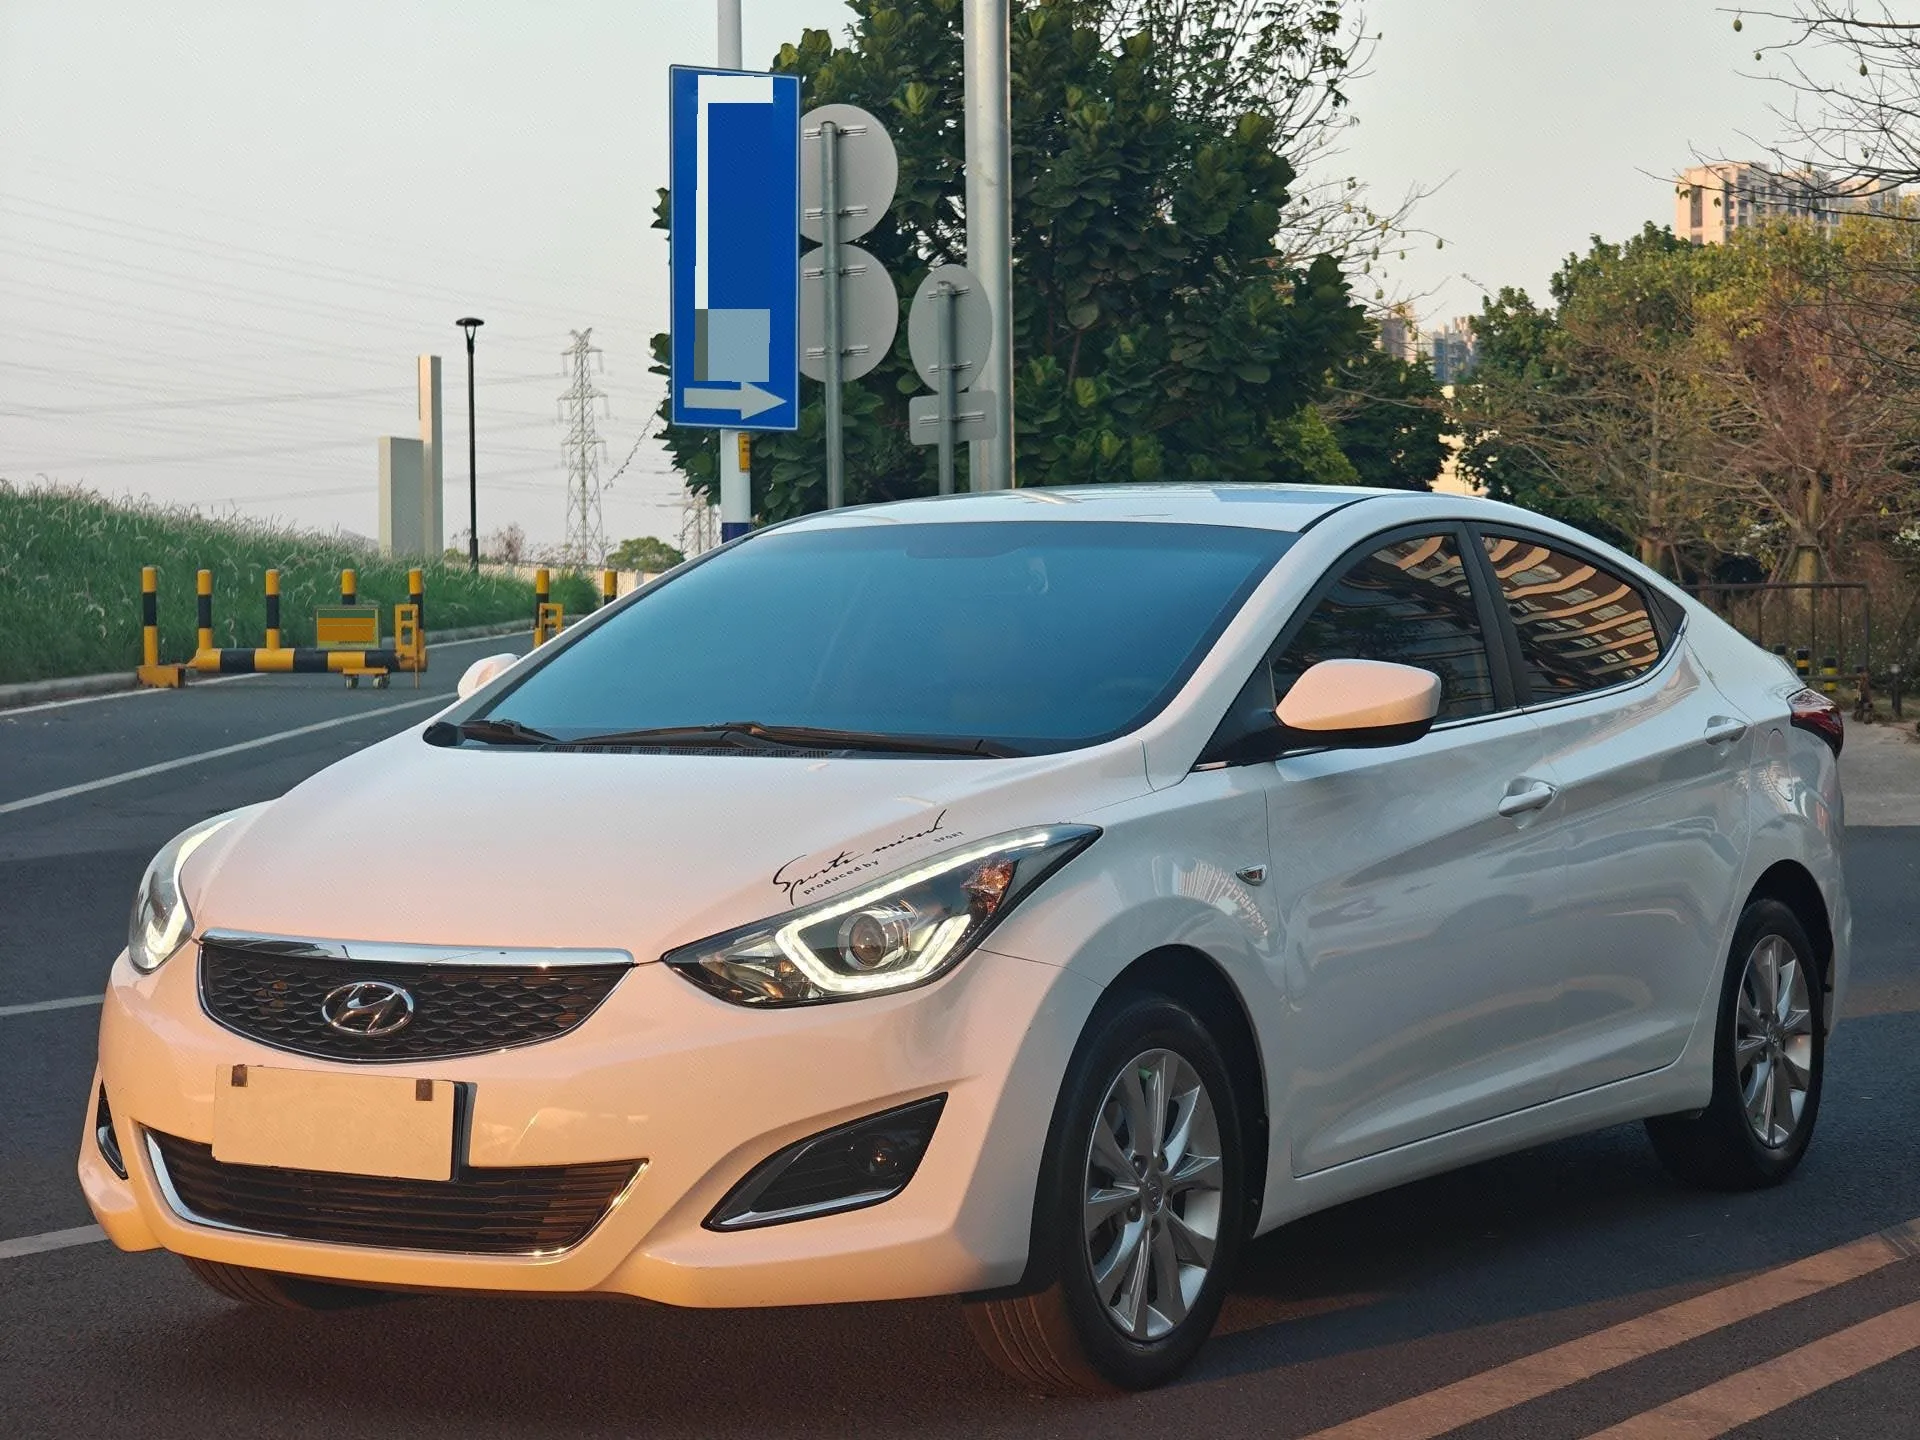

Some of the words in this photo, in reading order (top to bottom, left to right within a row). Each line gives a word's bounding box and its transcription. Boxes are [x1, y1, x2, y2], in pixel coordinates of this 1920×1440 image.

[803, 865, 861, 895] produced
[861, 859, 879, 870] by
[934, 831, 965, 843] SPORT
